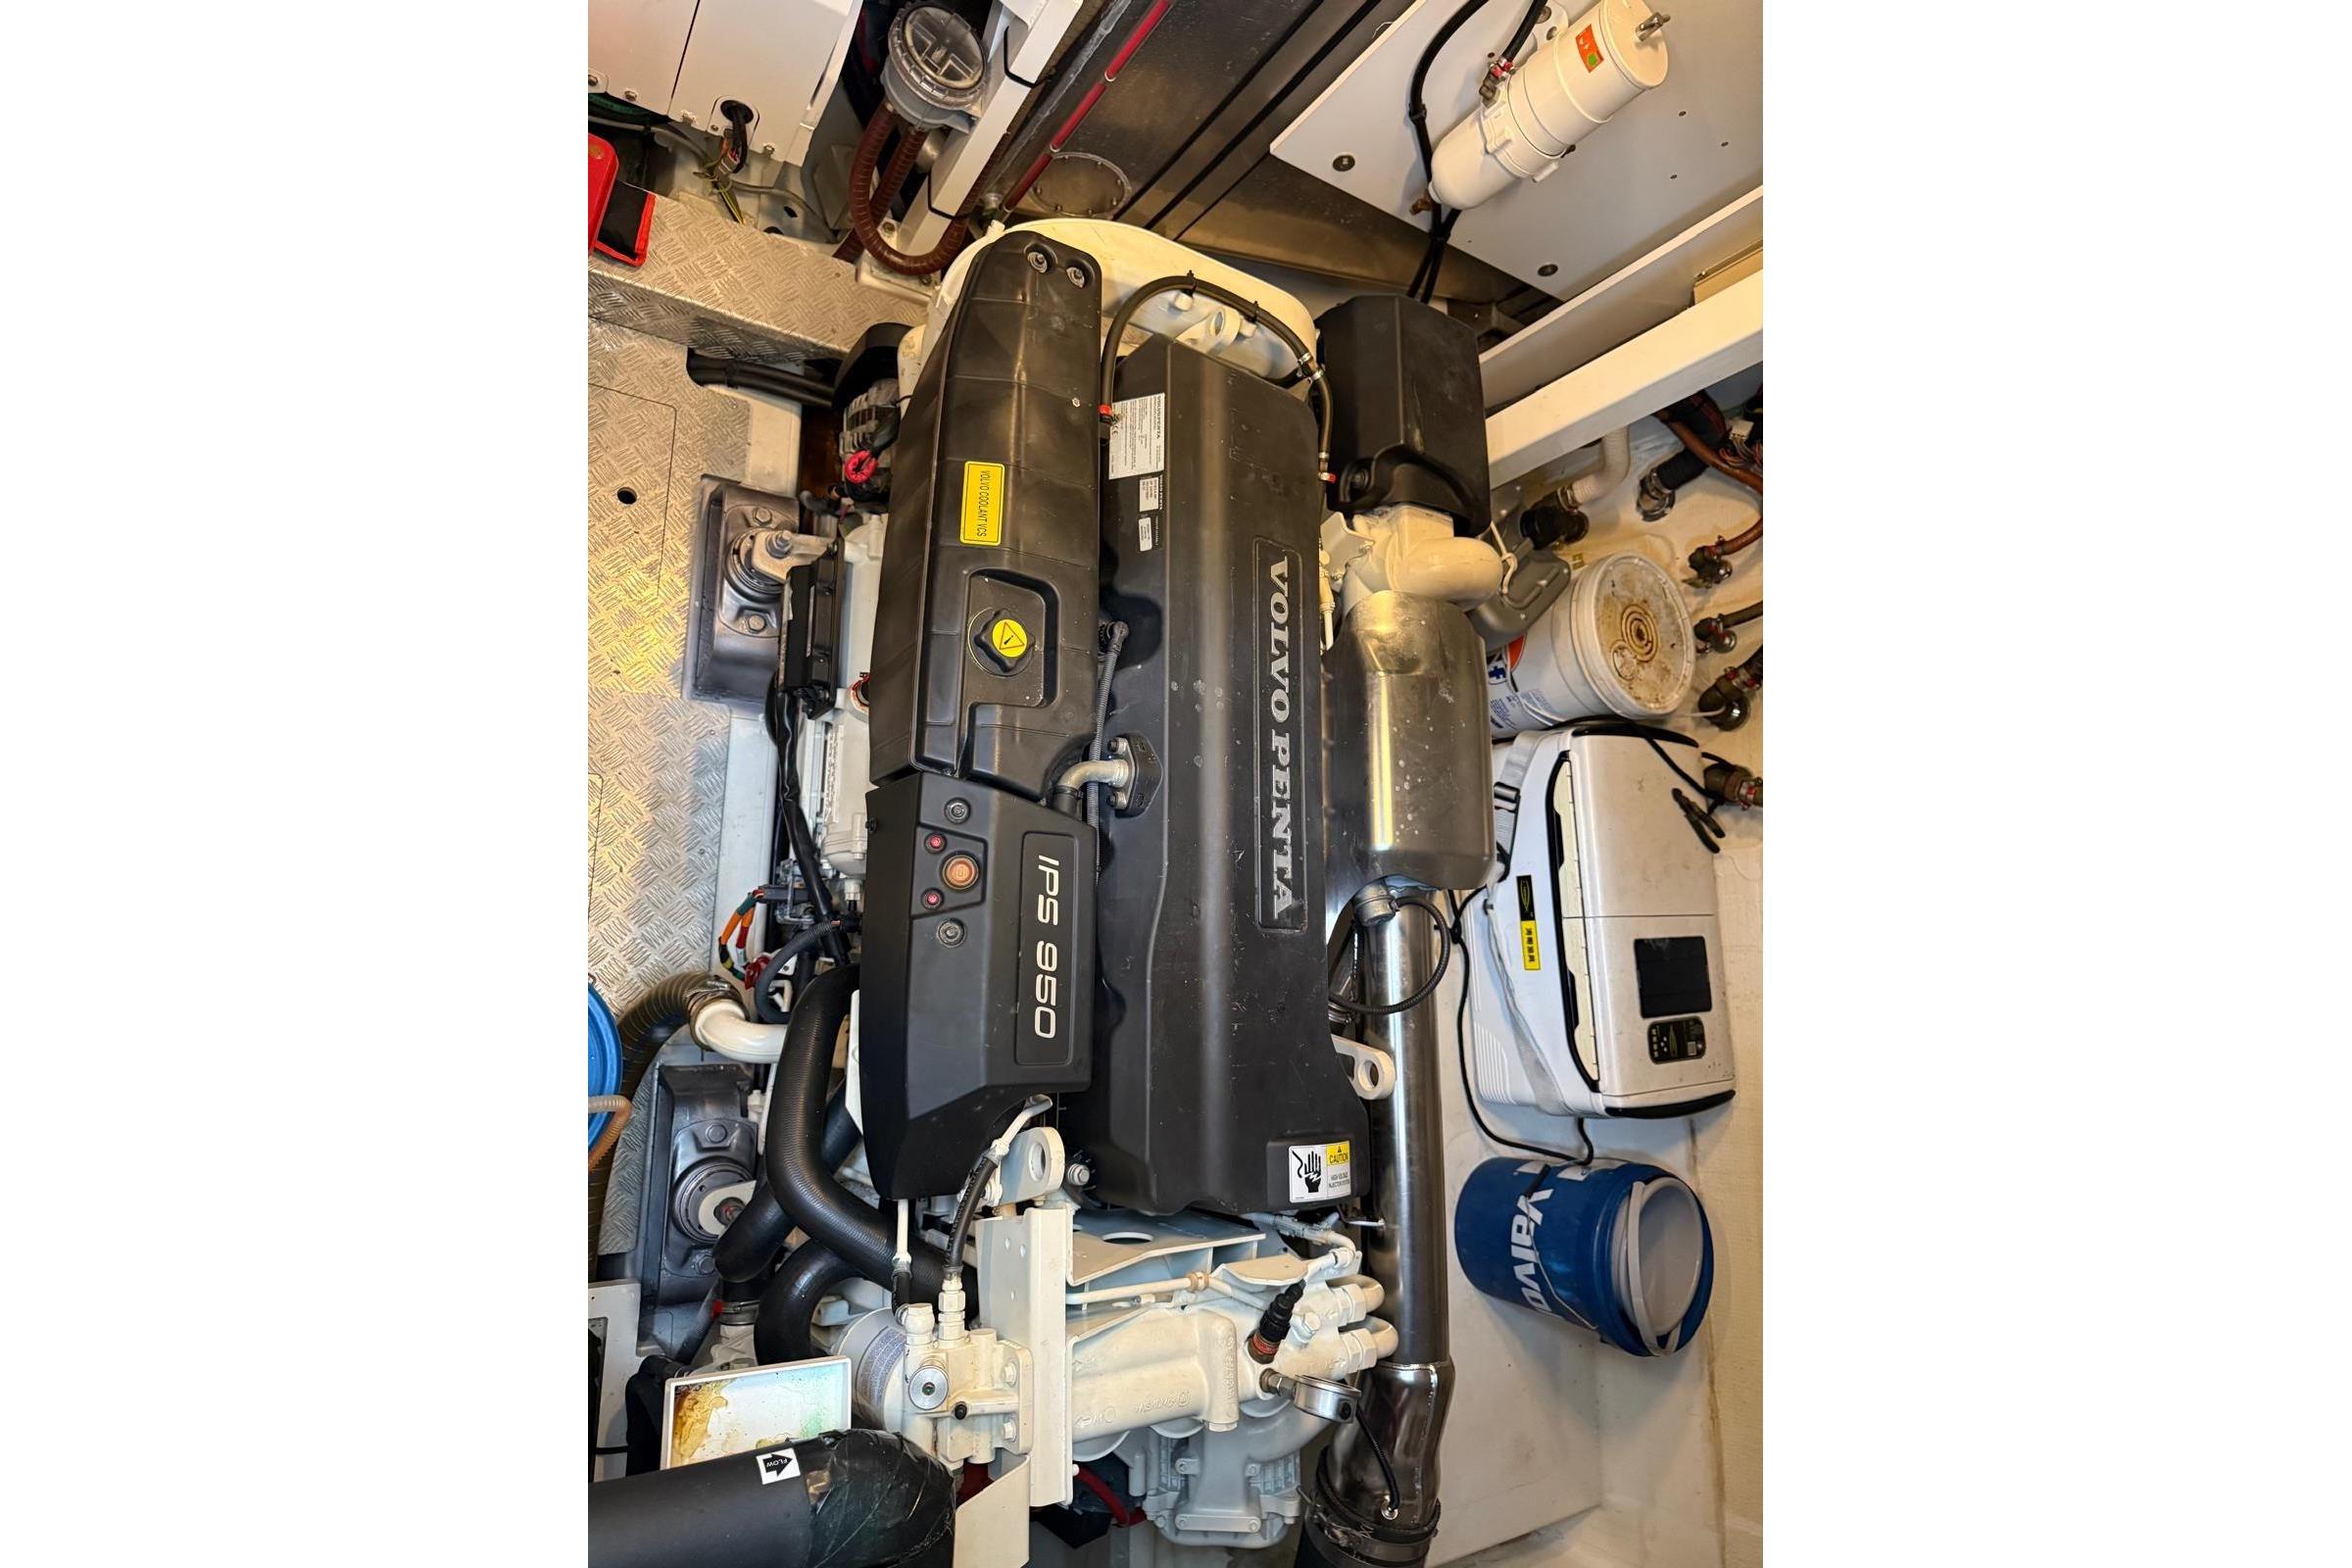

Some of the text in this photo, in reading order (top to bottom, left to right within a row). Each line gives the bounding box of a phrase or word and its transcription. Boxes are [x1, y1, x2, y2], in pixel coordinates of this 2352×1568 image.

[976, 470, 990, 537] VOLVO COOLANT VCS
[1270, 557, 1293, 919] VOLVO PENTA
[1034, 855, 1059, 1039] IPS 950
[1329, 1152, 1348, 1164] CAUTION
[1511, 1189, 1556, 1313] Valvo
[766, 1458, 788, 1468] FLOW
